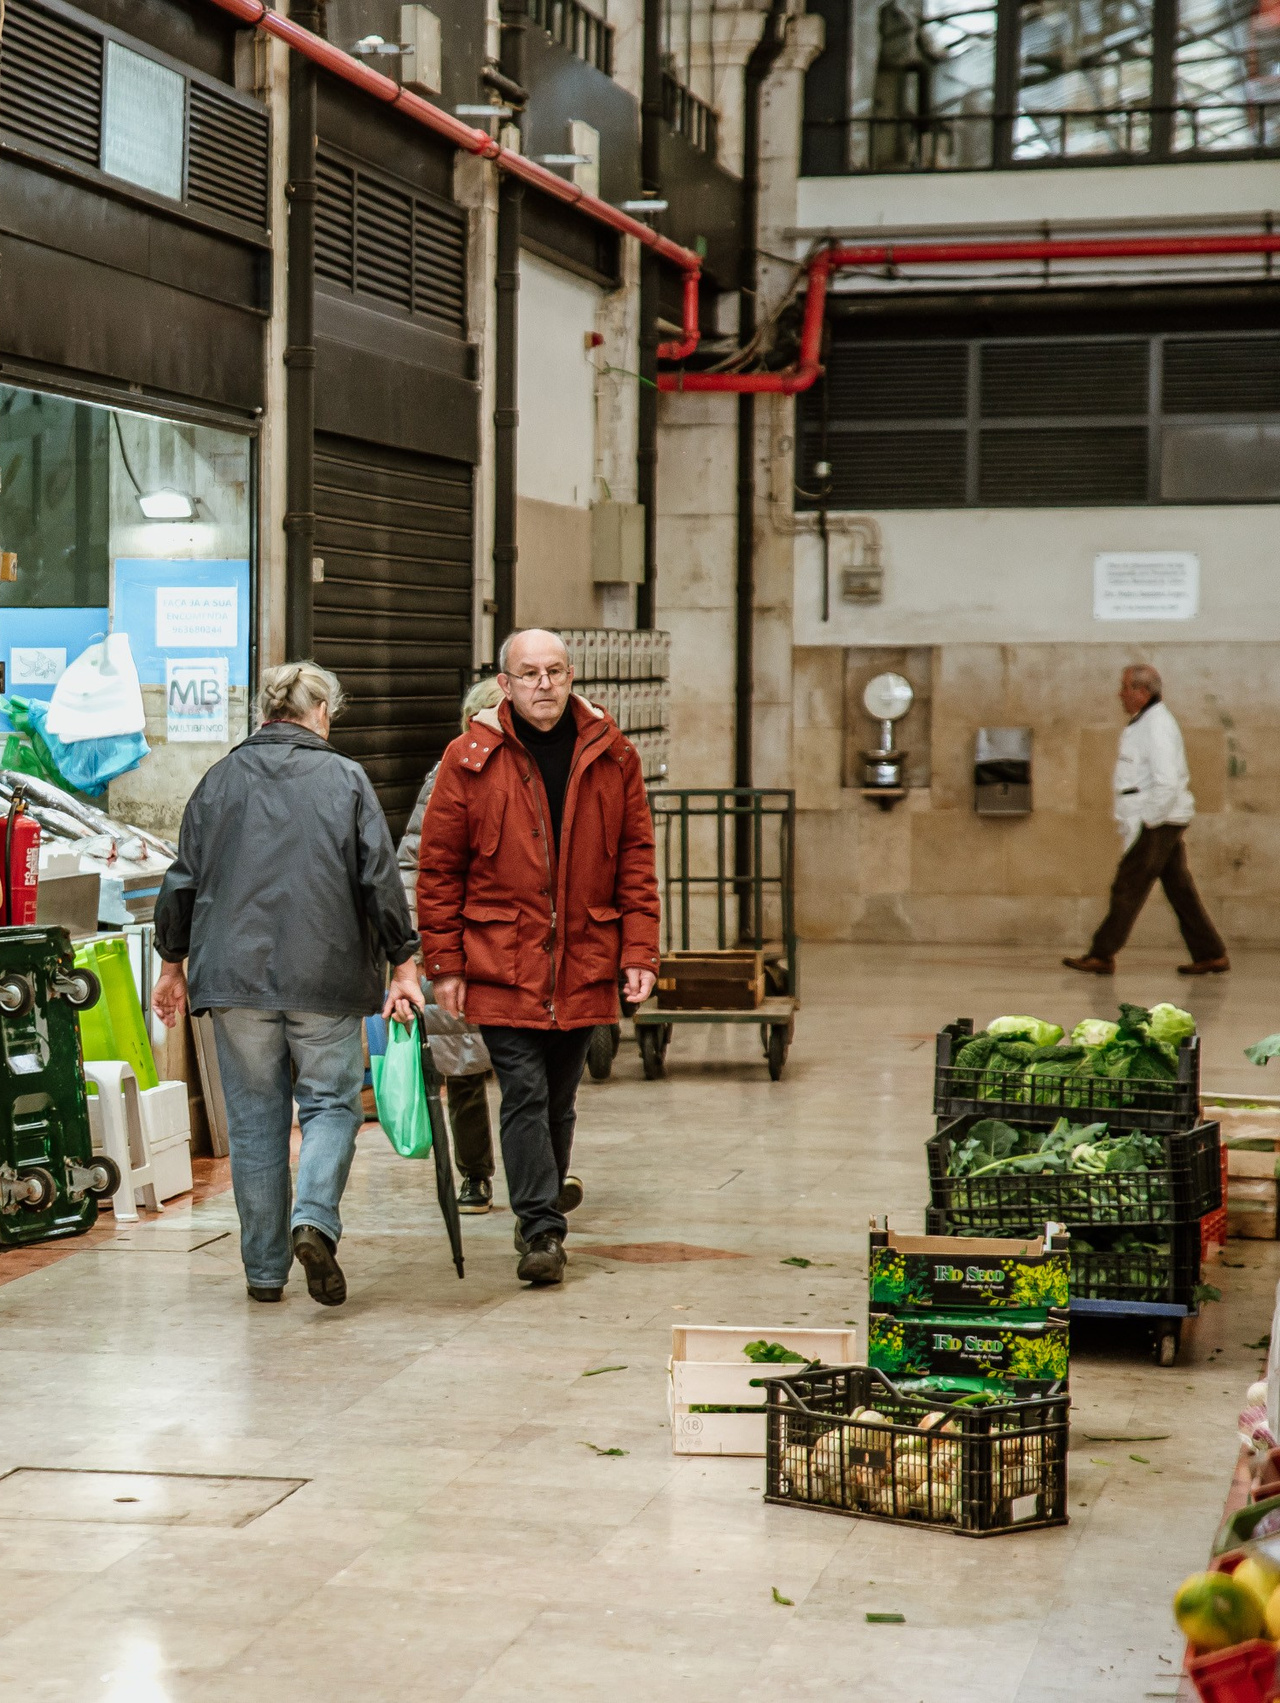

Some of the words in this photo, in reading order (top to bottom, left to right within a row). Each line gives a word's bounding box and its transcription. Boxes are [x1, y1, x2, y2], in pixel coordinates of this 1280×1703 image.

[212, 599, 232, 607] SUA
[169, 680, 222, 706] MB
[966, 1266, 1005, 1283] Seco
[964, 1335, 1004, 1353] Seco
[686, 1420, 699, 1430] 18
